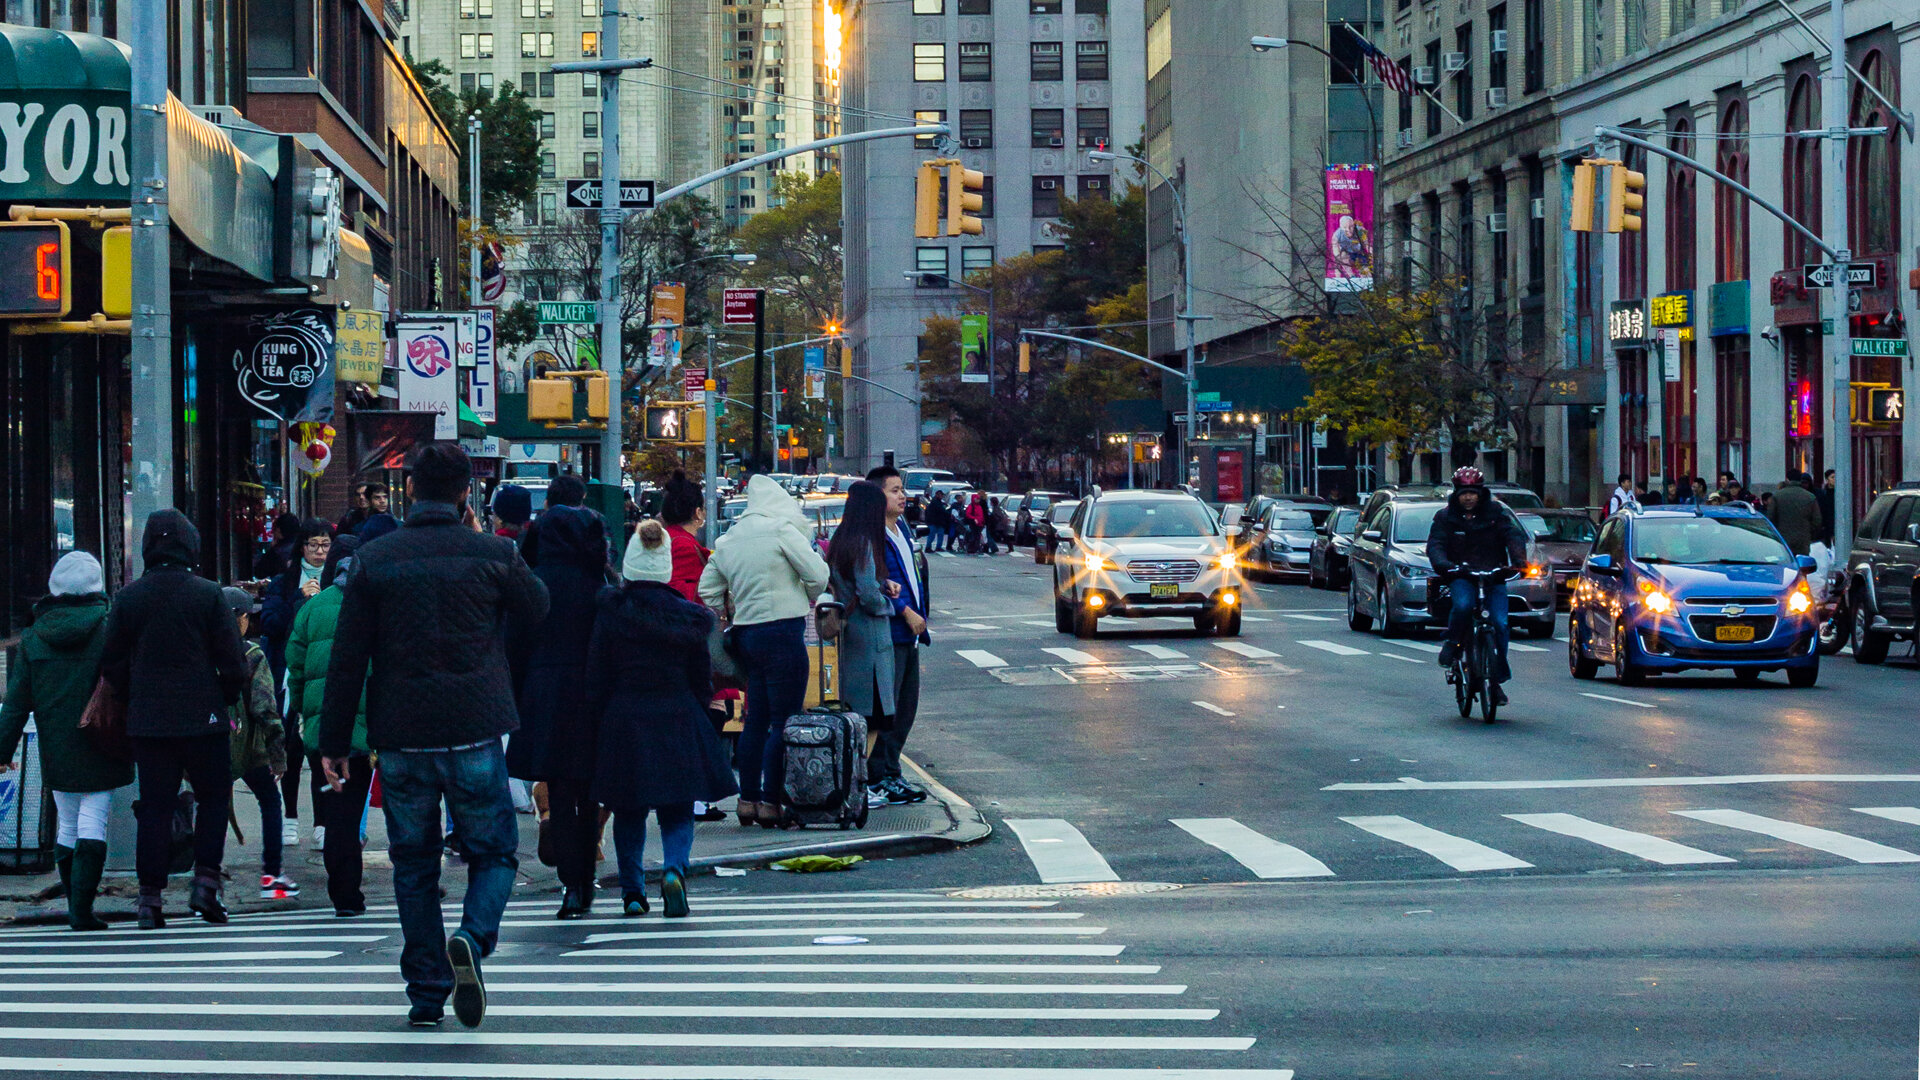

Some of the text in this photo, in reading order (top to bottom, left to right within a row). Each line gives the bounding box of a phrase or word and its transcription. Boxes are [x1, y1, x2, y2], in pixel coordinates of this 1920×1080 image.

[579, 187, 644, 200] ONE WAY
[36, 243, 59, 300] 6
[1815, 271, 1866, 281] ONE WAY
[480, 312, 492, 321] HR
[541, 304, 586, 321] WALKER
[262, 343, 297, 355] KUNG
[1854, 340, 1896, 354] WALKER
[262, 355, 277, 366] FU
[405, 337, 452, 376] 味
[262, 366, 284, 377] TEA
[408, 401, 450, 411] MIKA
[484, 443, 497, 453] HR
